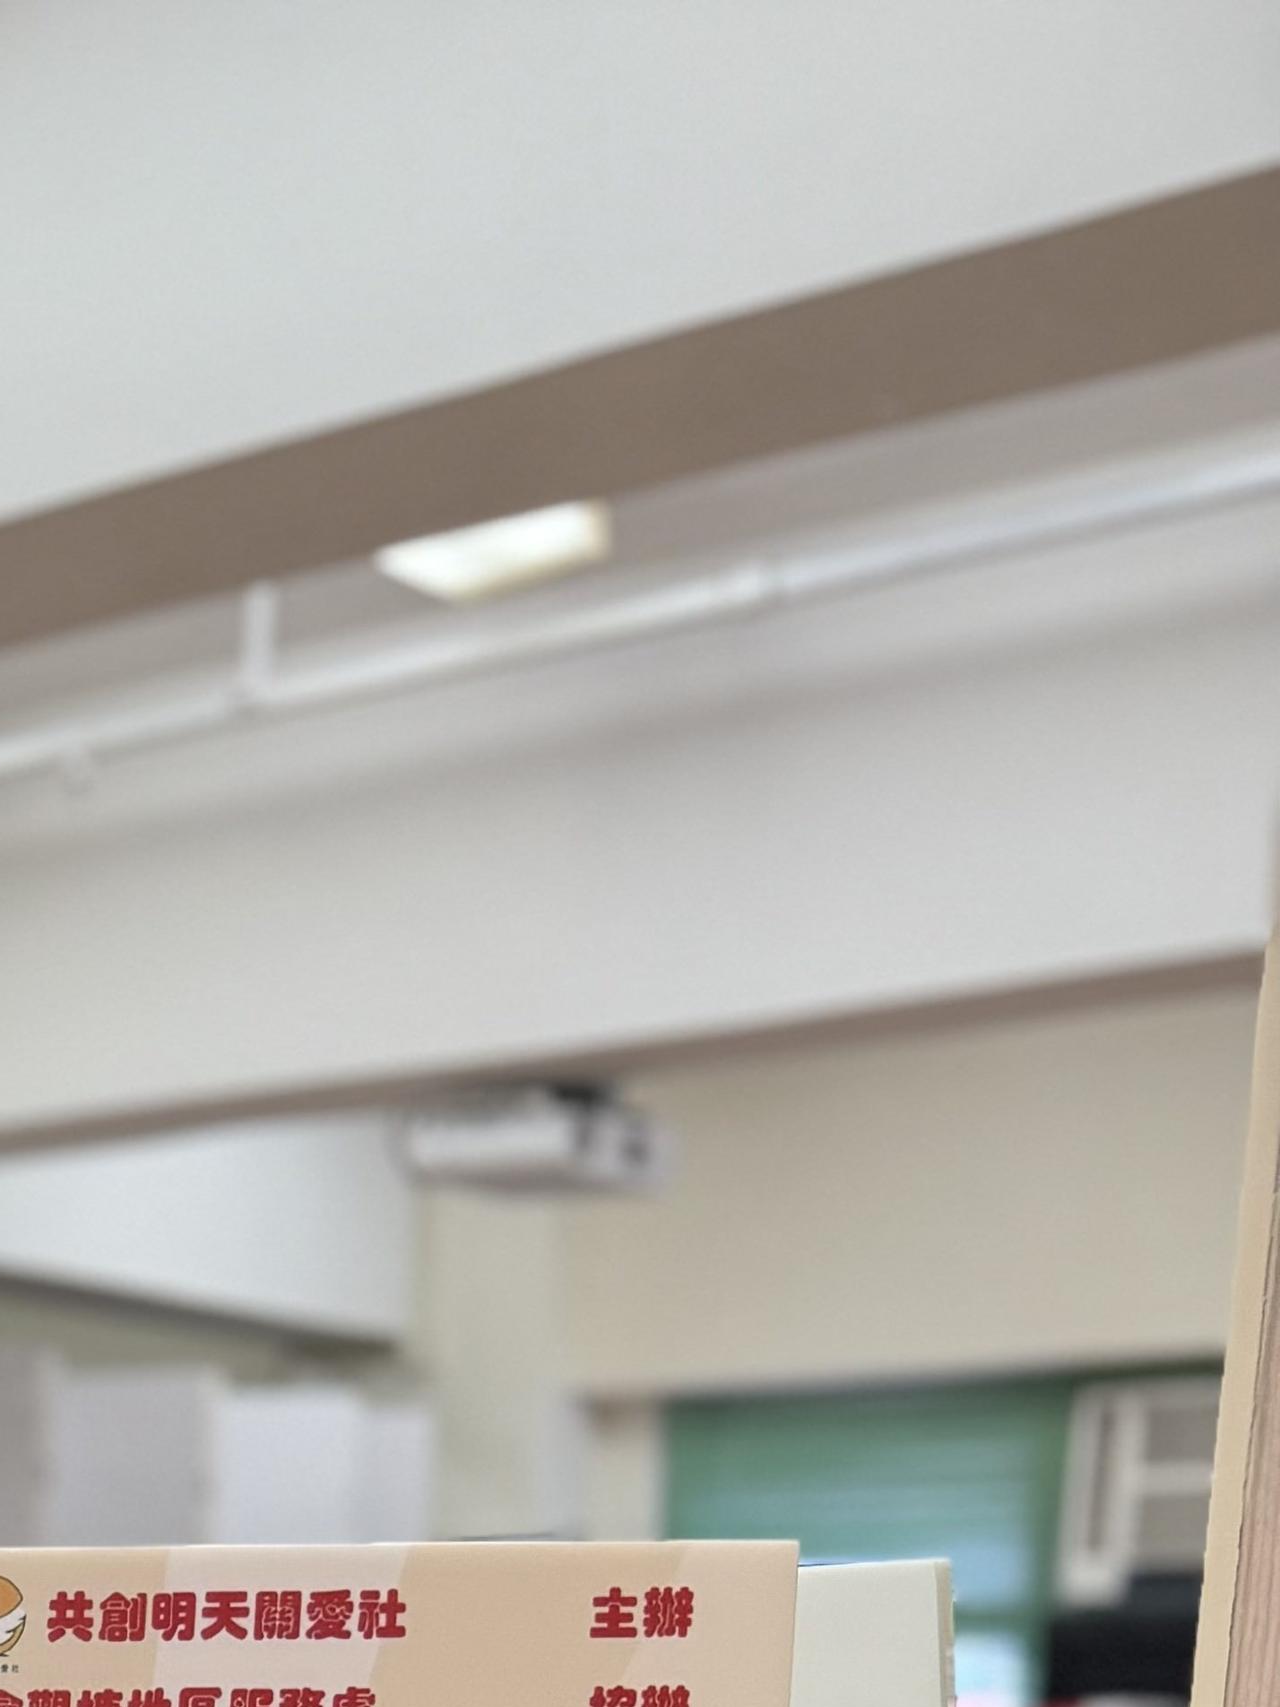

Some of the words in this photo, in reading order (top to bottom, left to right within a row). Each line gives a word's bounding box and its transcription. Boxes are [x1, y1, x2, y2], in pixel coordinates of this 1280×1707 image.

[47, 1588, 407, 1642] 共創明天關愛社
[589, 1586, 695, 1639] 主辦
